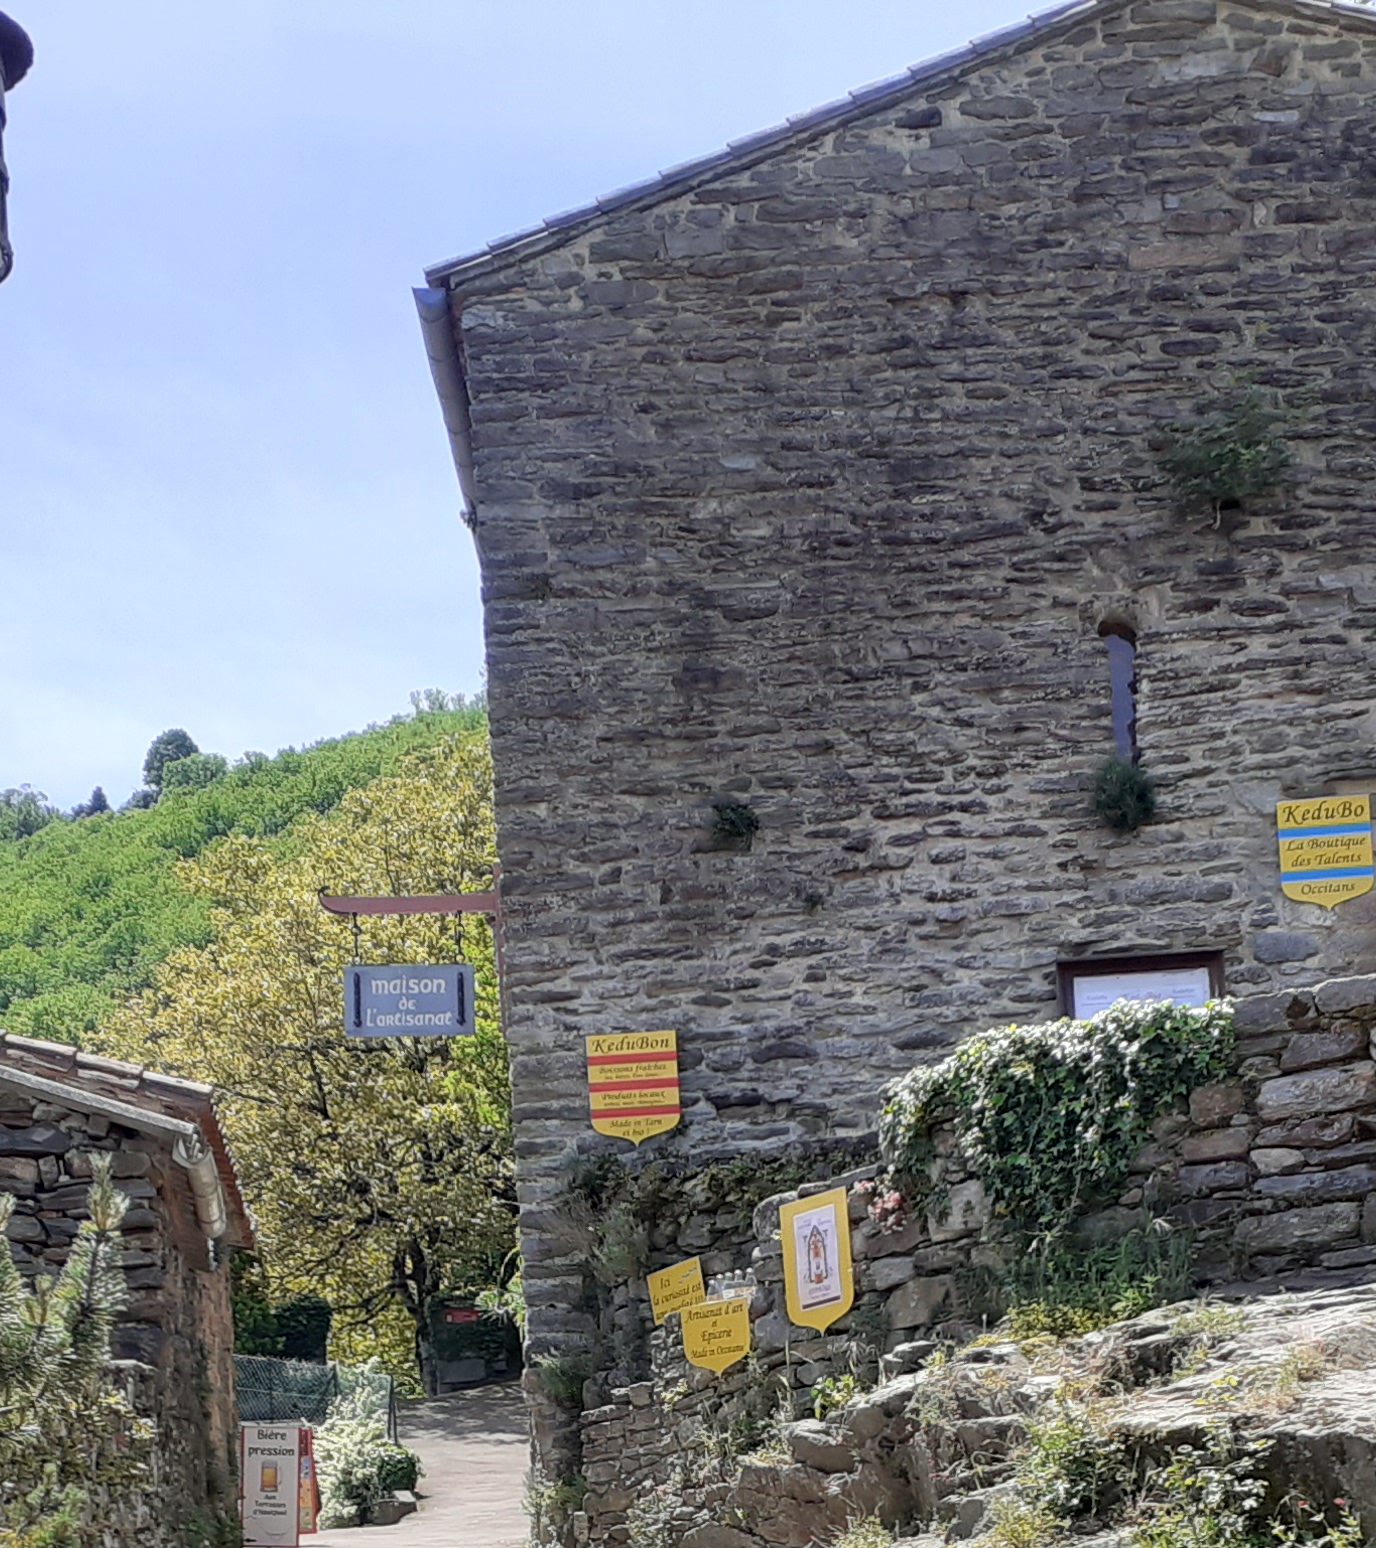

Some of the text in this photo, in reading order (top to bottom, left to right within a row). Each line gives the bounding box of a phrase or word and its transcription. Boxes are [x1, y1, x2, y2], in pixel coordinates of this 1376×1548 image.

[1285, 836, 1366, 852] La Boutique
[1291, 851, 1362, 868] des Talents
[1300, 882, 1356, 895] Occitans
[370, 975, 446, 995] maison
[398, 996, 417, 1010] de
[591, 1035, 670, 1054] KeduBon
[257, 1429, 287, 1441] Bière
[248, 1445, 295, 1458] pression
